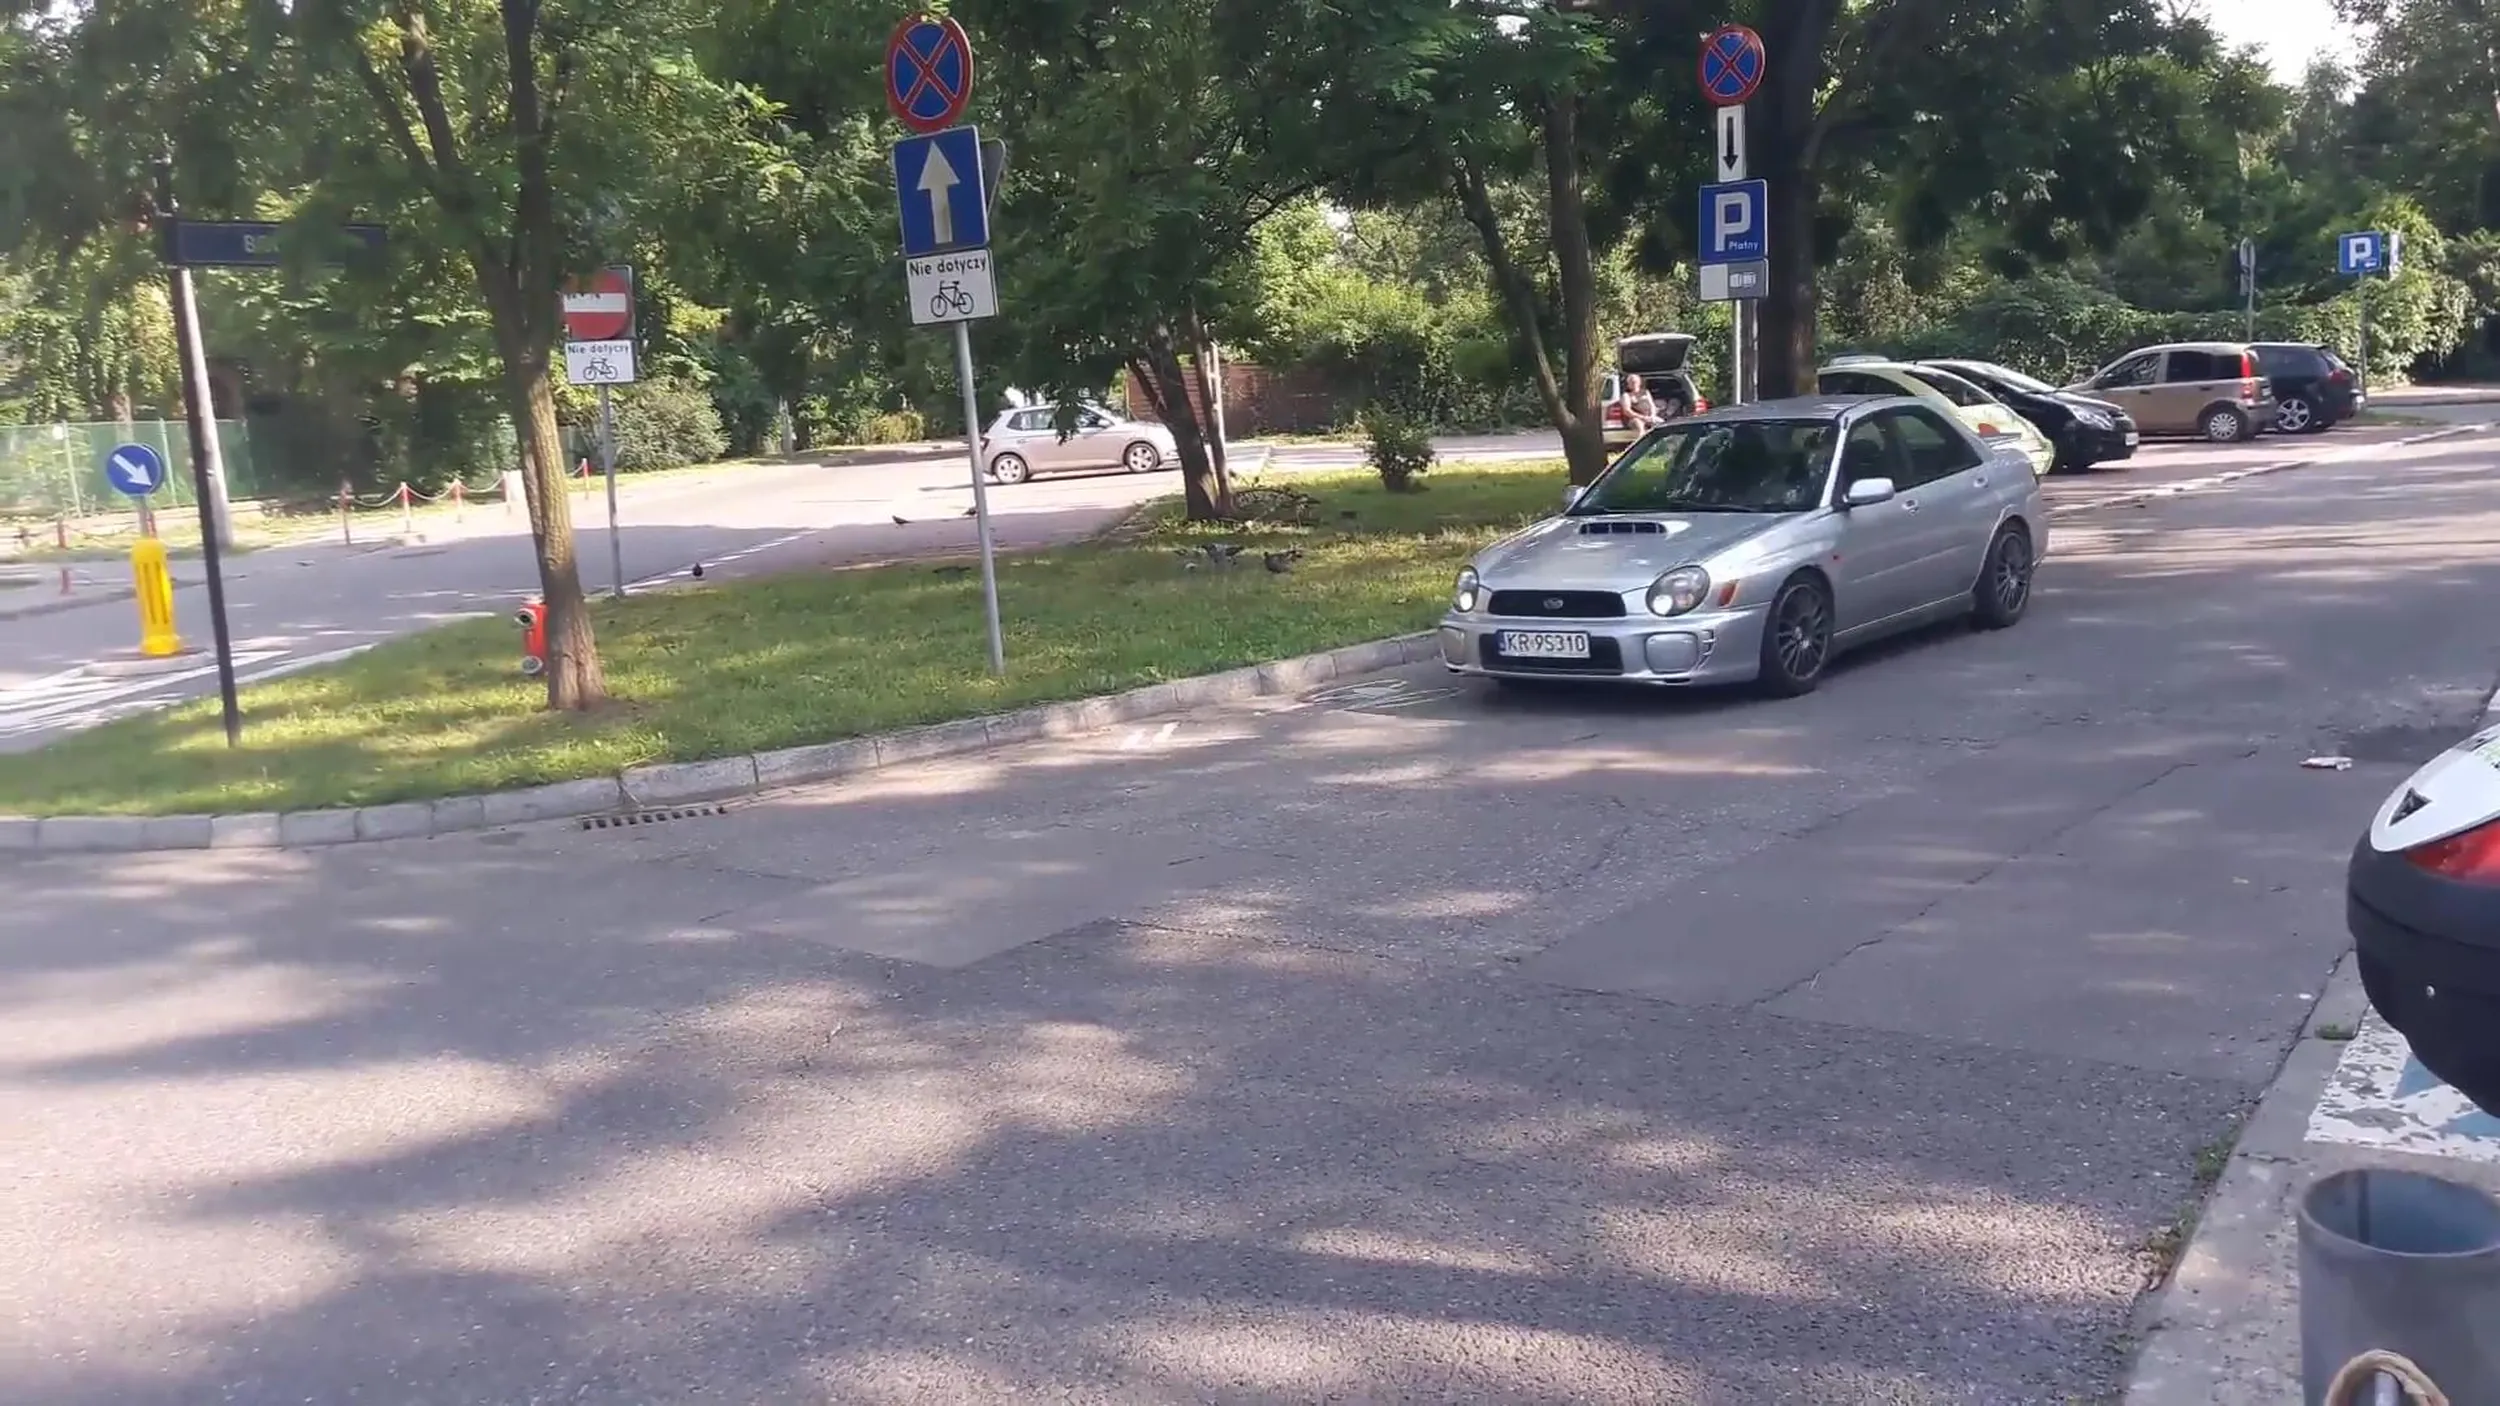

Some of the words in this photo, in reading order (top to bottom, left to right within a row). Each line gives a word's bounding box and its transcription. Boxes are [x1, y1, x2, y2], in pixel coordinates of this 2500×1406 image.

[1715, 192, 1751, 252] P
[2349, 237, 2372, 268] P
[909, 261, 931, 276] Nie
[937, 257, 986, 275] dotyczy
[568, 344, 586, 354] Nie
[590, 343, 629, 355] dotyczy
[1507, 633, 1529, 652] KR
[1535, 634, 1585, 652] 9S310
